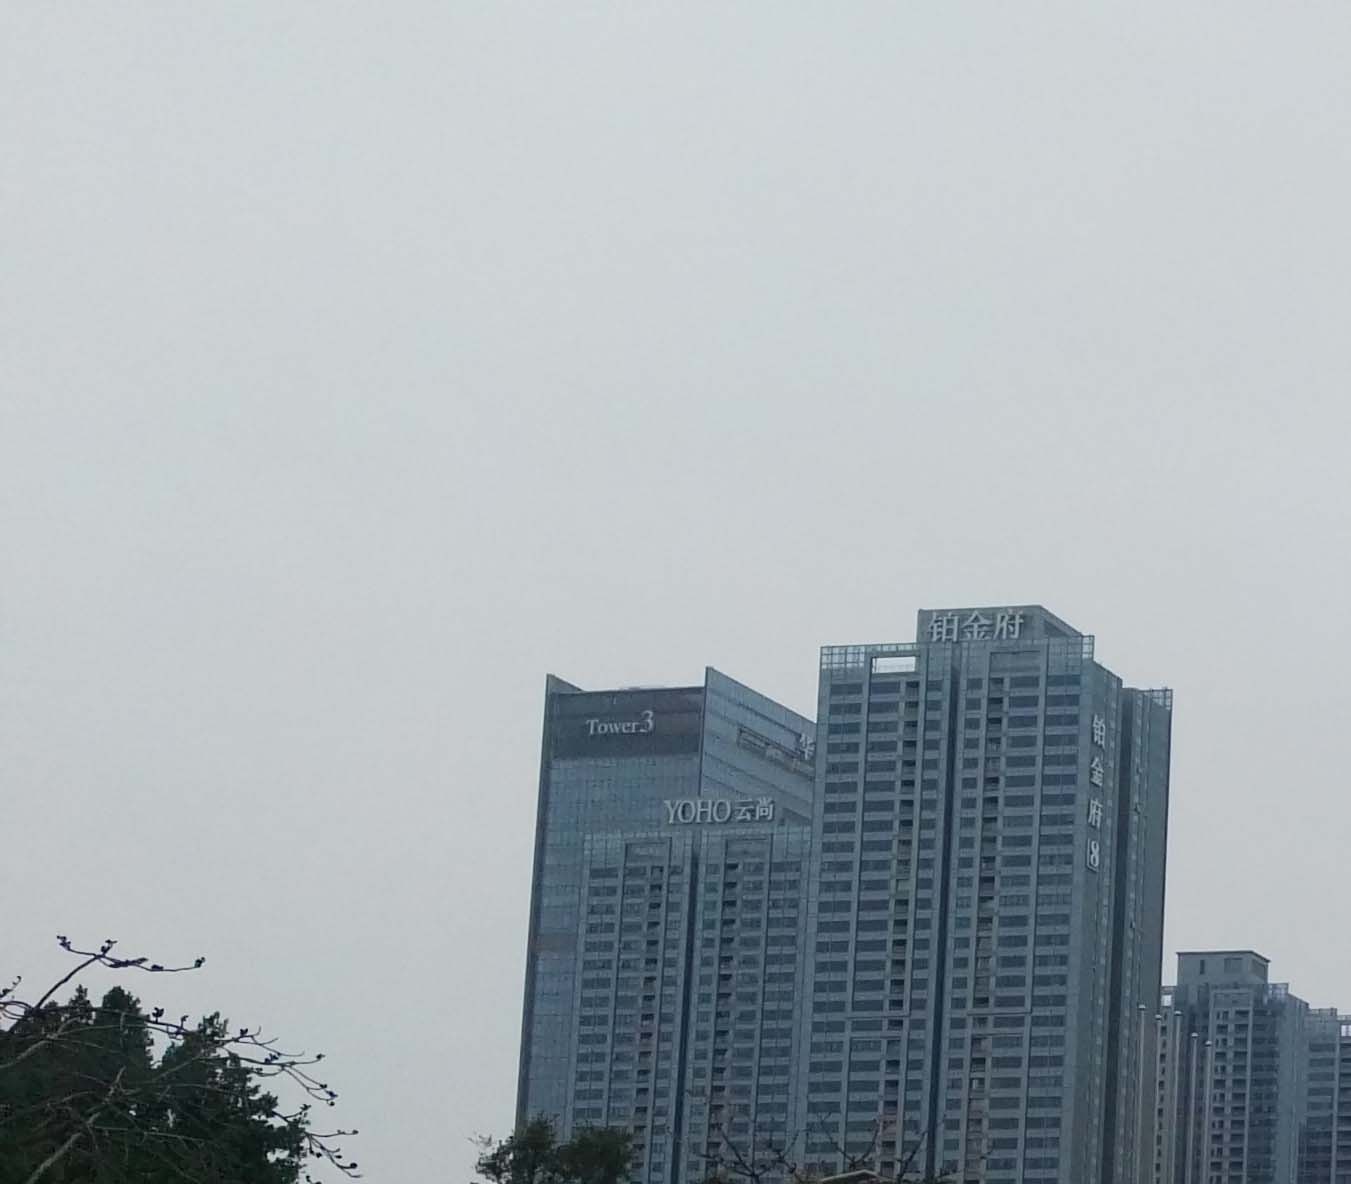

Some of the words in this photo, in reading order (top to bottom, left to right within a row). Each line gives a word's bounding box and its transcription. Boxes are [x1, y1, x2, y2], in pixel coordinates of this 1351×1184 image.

[928, 609, 1024, 643] 铂金府
[664, 800, 731, 825] YOHO
[735, 797, 774, 821] 云尚
